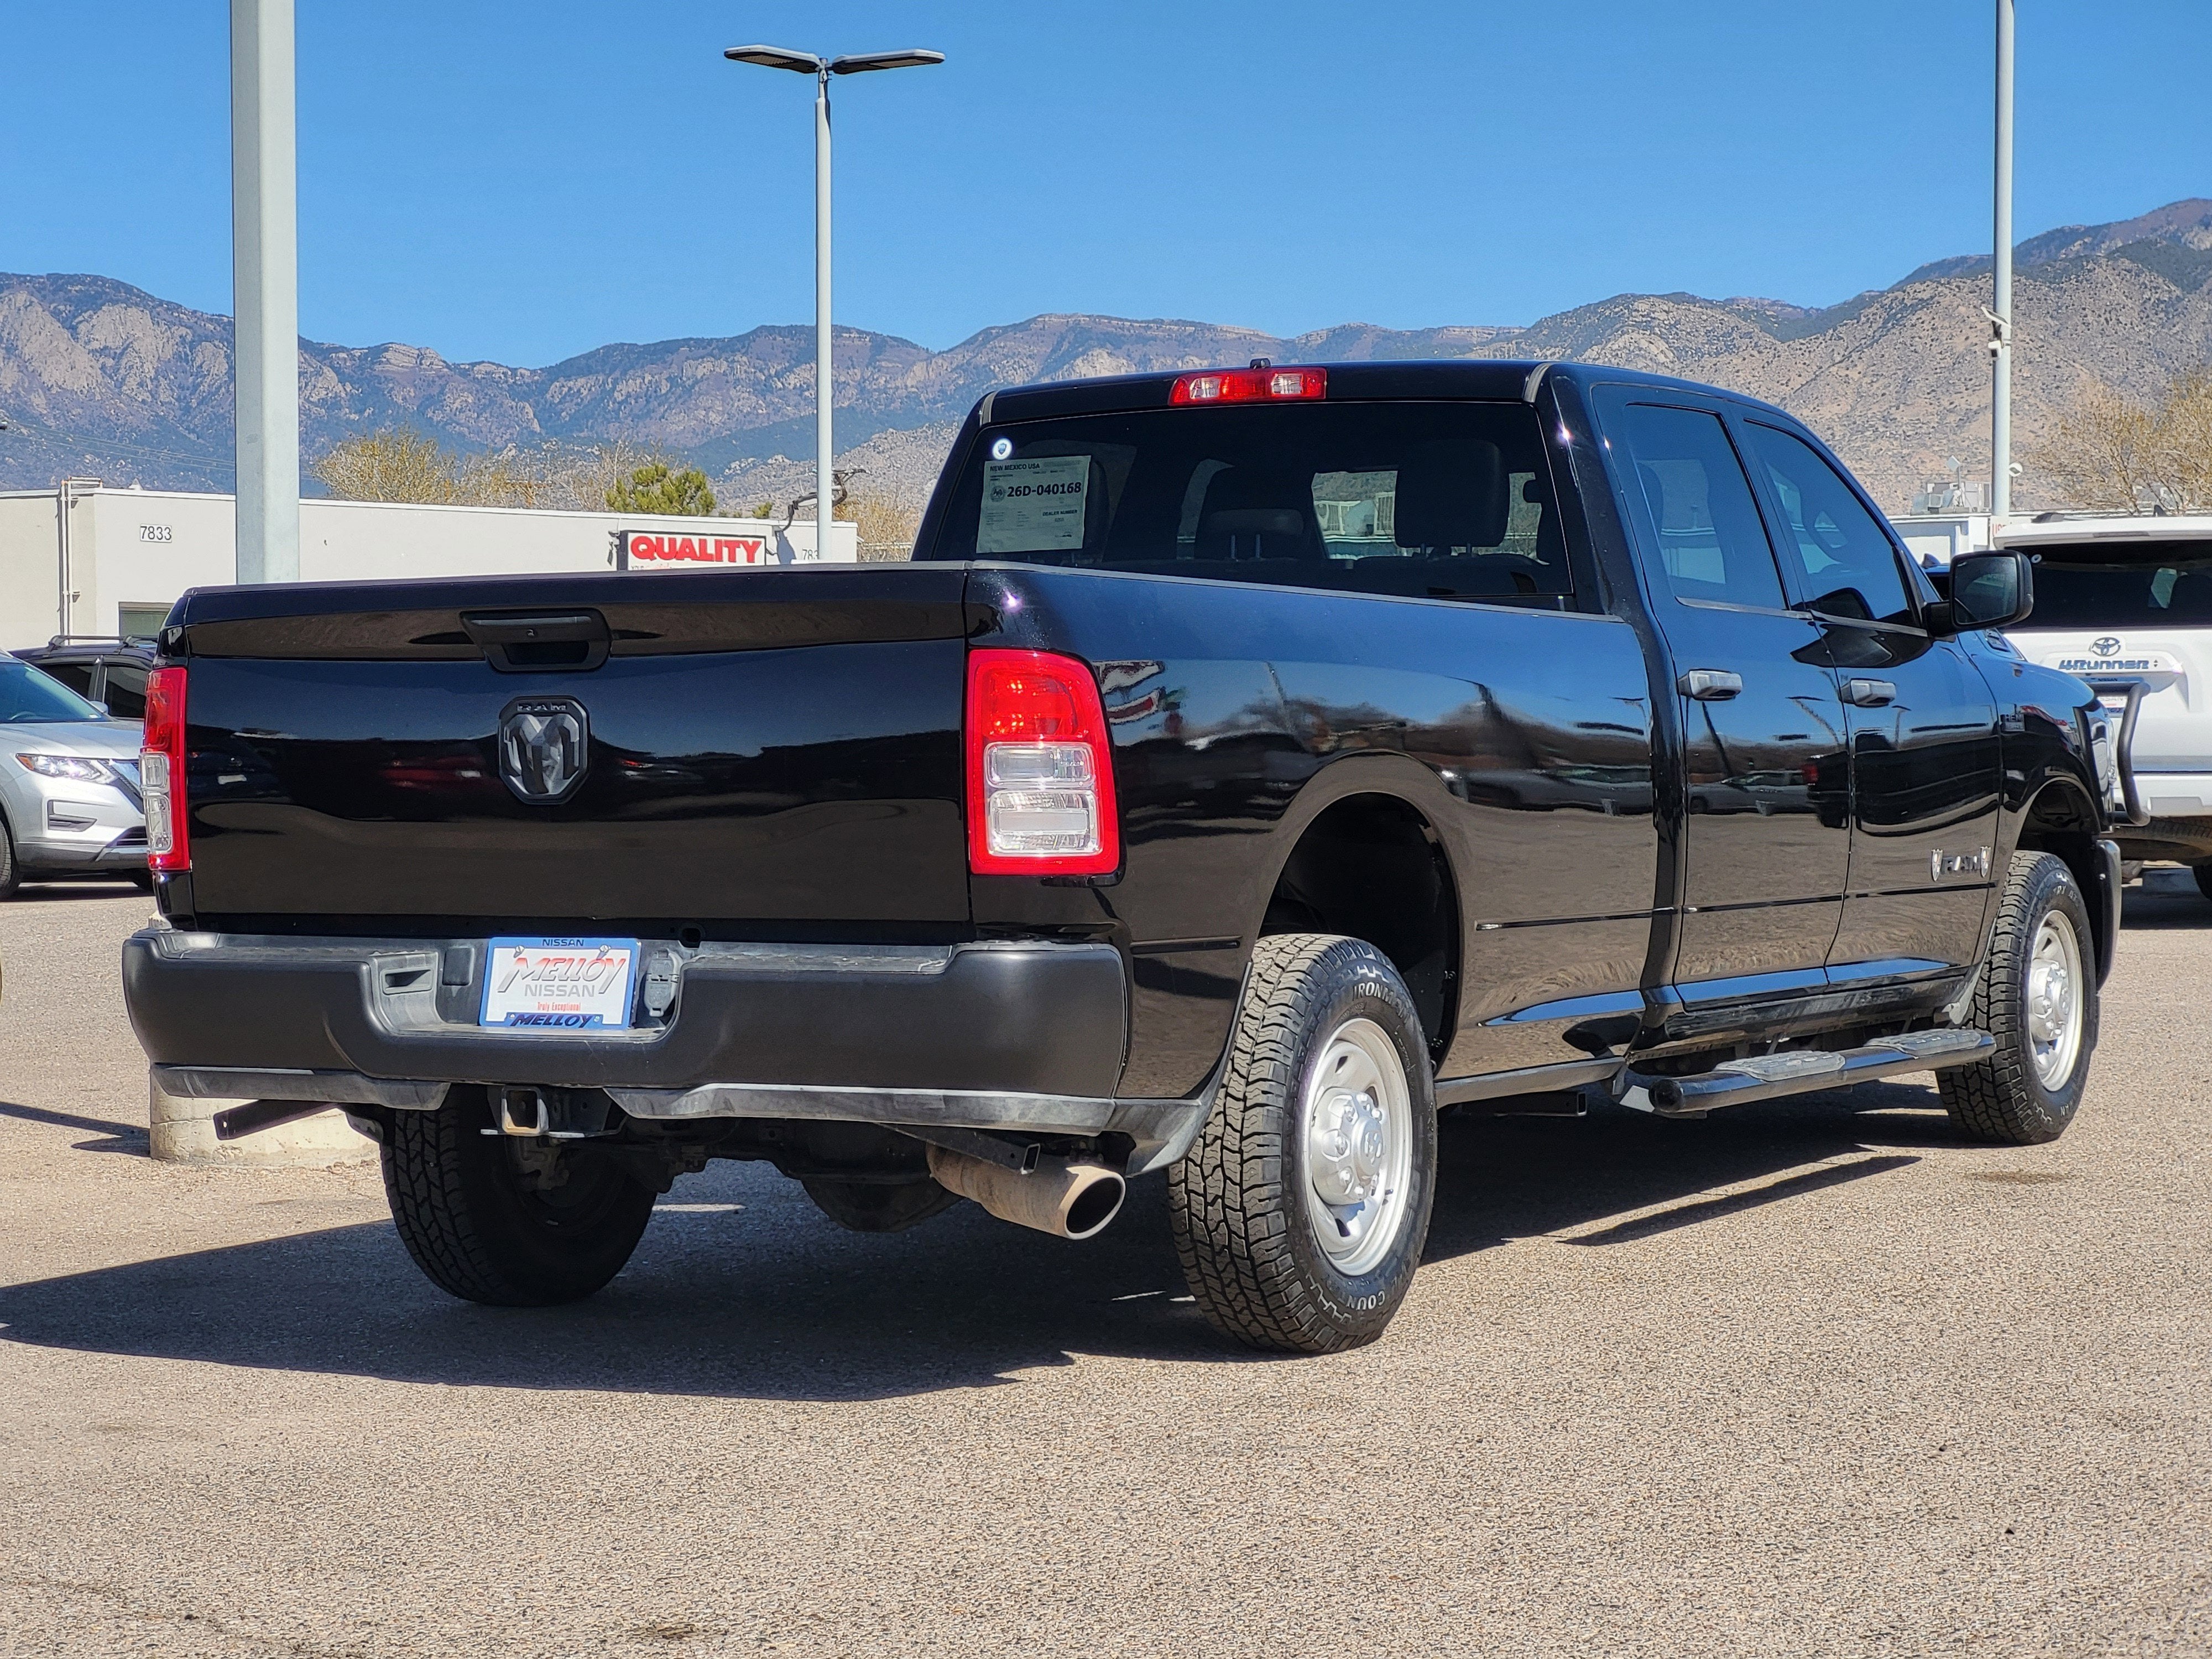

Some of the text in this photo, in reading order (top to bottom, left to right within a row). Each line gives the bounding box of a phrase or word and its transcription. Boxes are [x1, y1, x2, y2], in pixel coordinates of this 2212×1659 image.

[1007, 482, 1082, 497] 26D-040168
[140, 526, 171, 540] 7833
[630, 535, 761, 563] QUALITY
[517, 702, 567, 711] RAM
[542, 938, 584, 947] NISSAN
[498, 957, 626, 994] MELLOY
[525, 984, 596, 997] NISSAN
[538, 1002, 581, 1011] Truly Exceptional
[510, 1014, 593, 1028] MELLOY
